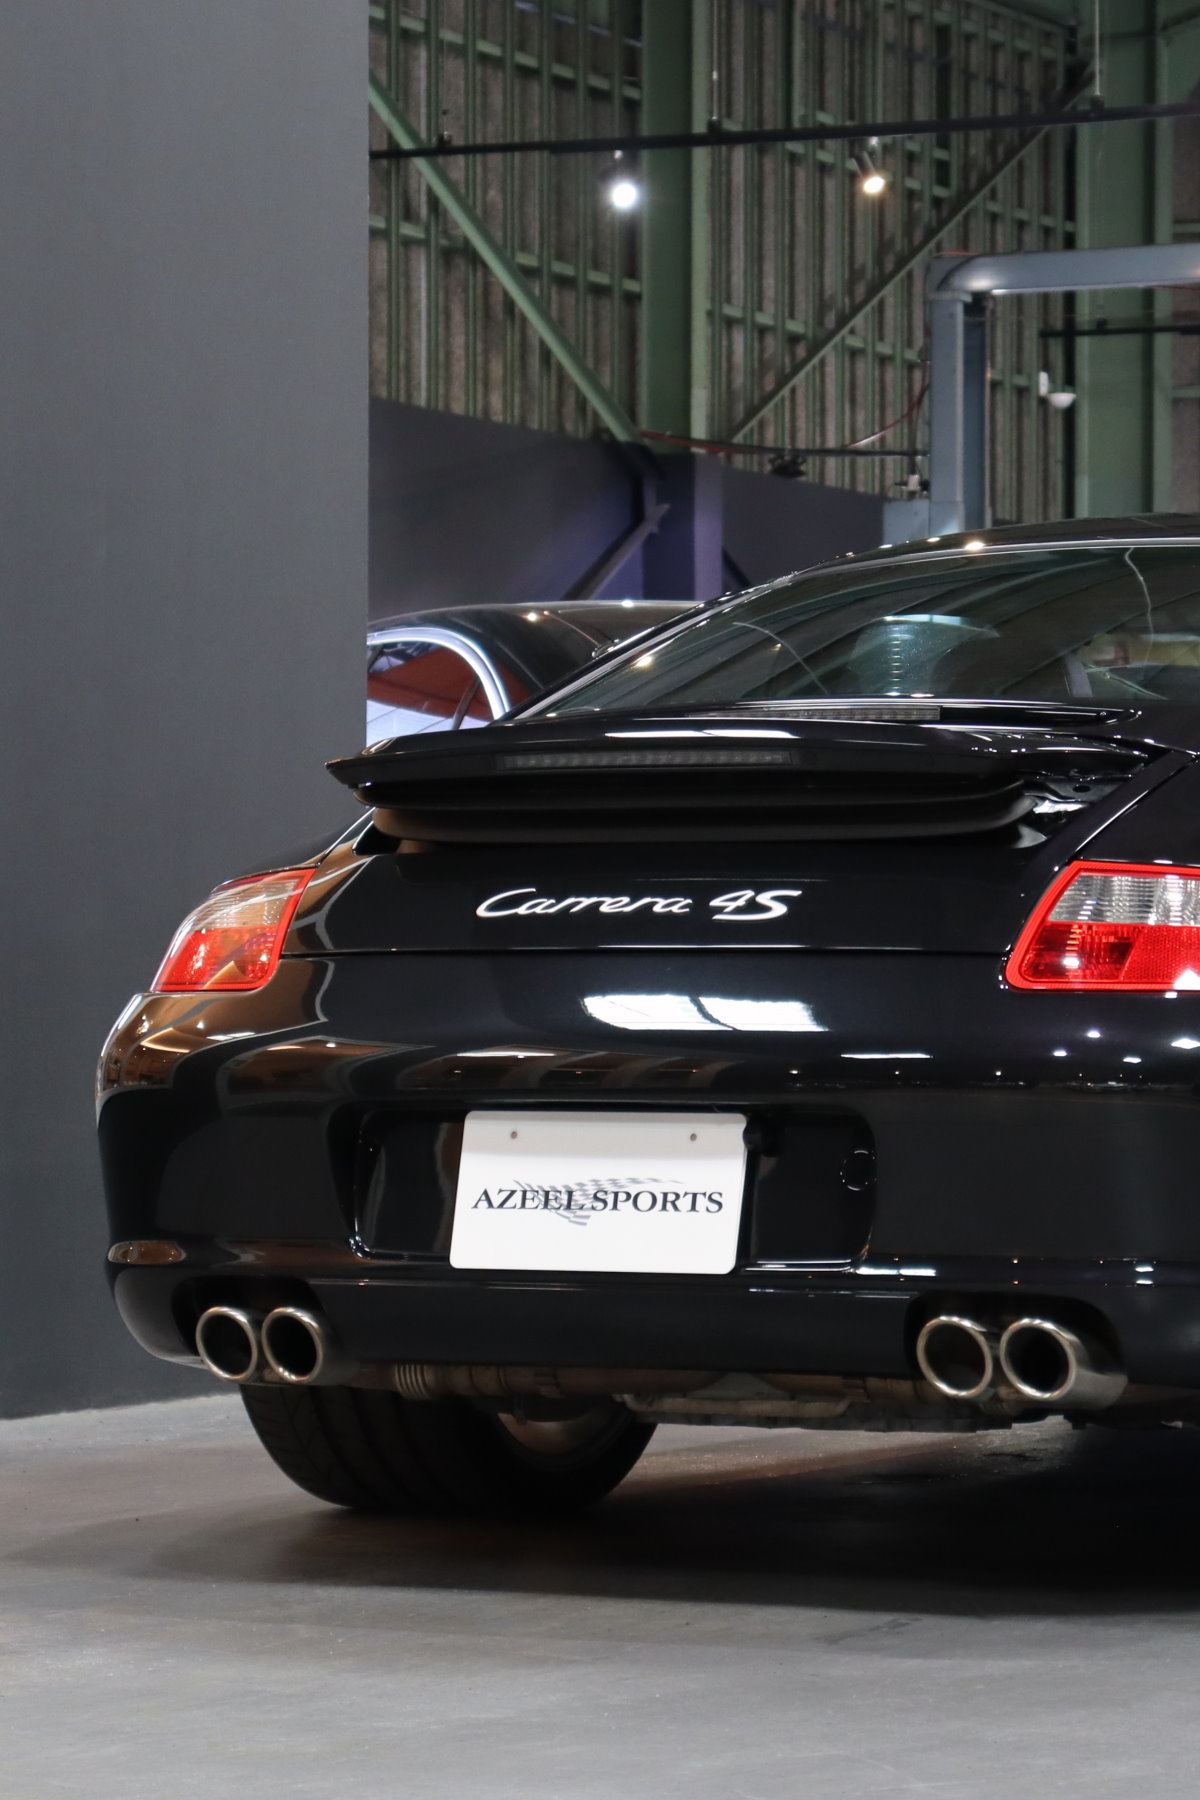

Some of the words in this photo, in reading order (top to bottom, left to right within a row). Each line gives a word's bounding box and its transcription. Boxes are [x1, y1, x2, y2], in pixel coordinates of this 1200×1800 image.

[475, 887, 693, 918] Carrera
[708, 889, 803, 921] 4S
[470, 1187, 587, 1211] AZEEL
[590, 1189, 724, 1213] SPORTS
